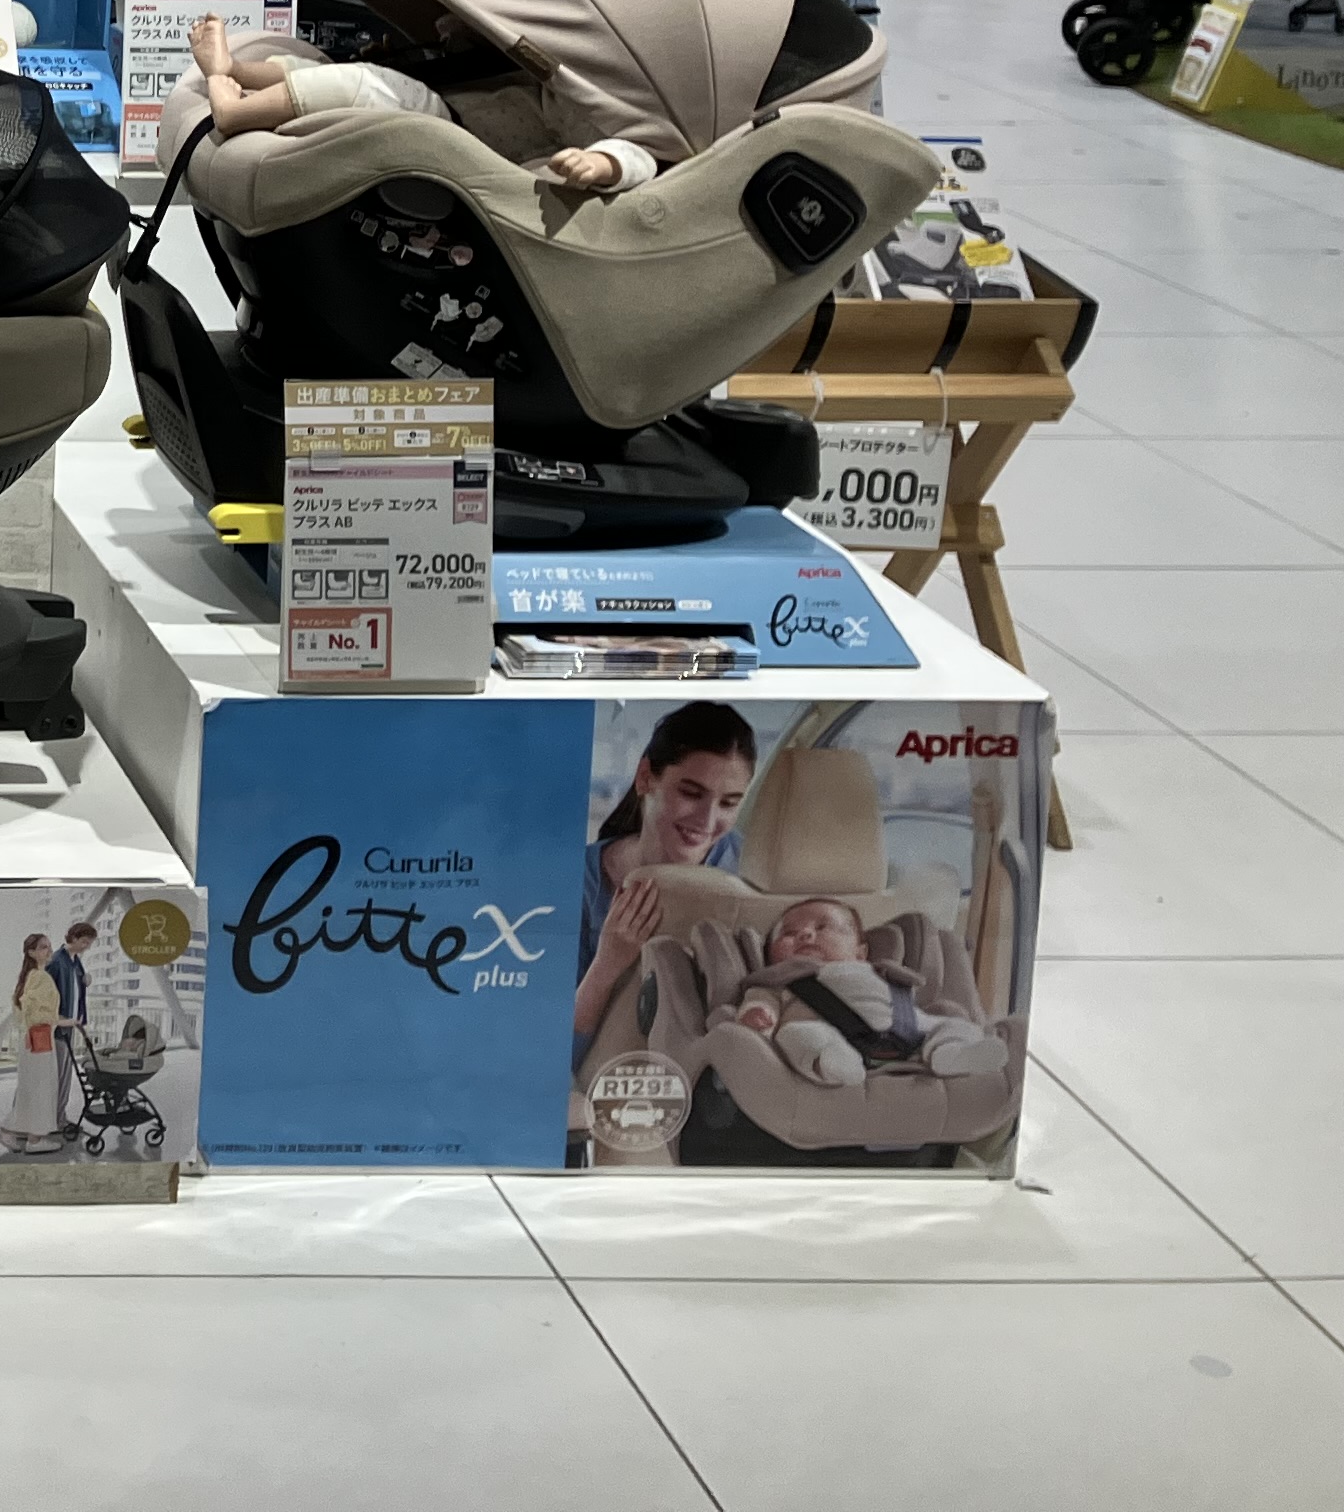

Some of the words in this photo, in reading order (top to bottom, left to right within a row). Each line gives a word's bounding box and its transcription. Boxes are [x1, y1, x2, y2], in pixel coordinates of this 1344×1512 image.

[131, 29, 162, 39] プラス
[165, 30, 181, 39] AB
[297, 387, 480, 405] 出産準備おまとめフェア
[812, 468, 941, 505] ,000円
[292, 499, 343, 512] クルリラ
[348, 499, 385, 512] ビッテ
[388, 499, 438, 511] エックス
[292, 516, 331, 529] プラス
[334, 517, 353, 528] AB
[395, 554, 486, 575] 72,000円
[508, 589, 587, 614] 首が楽
[328, 618, 379, 651] No.1
[896, 727, 1020, 763] Aprica
[364, 846, 474, 874] Cururila
[222, 834, 467, 996] bitte
[474, 964, 529, 993] plus
